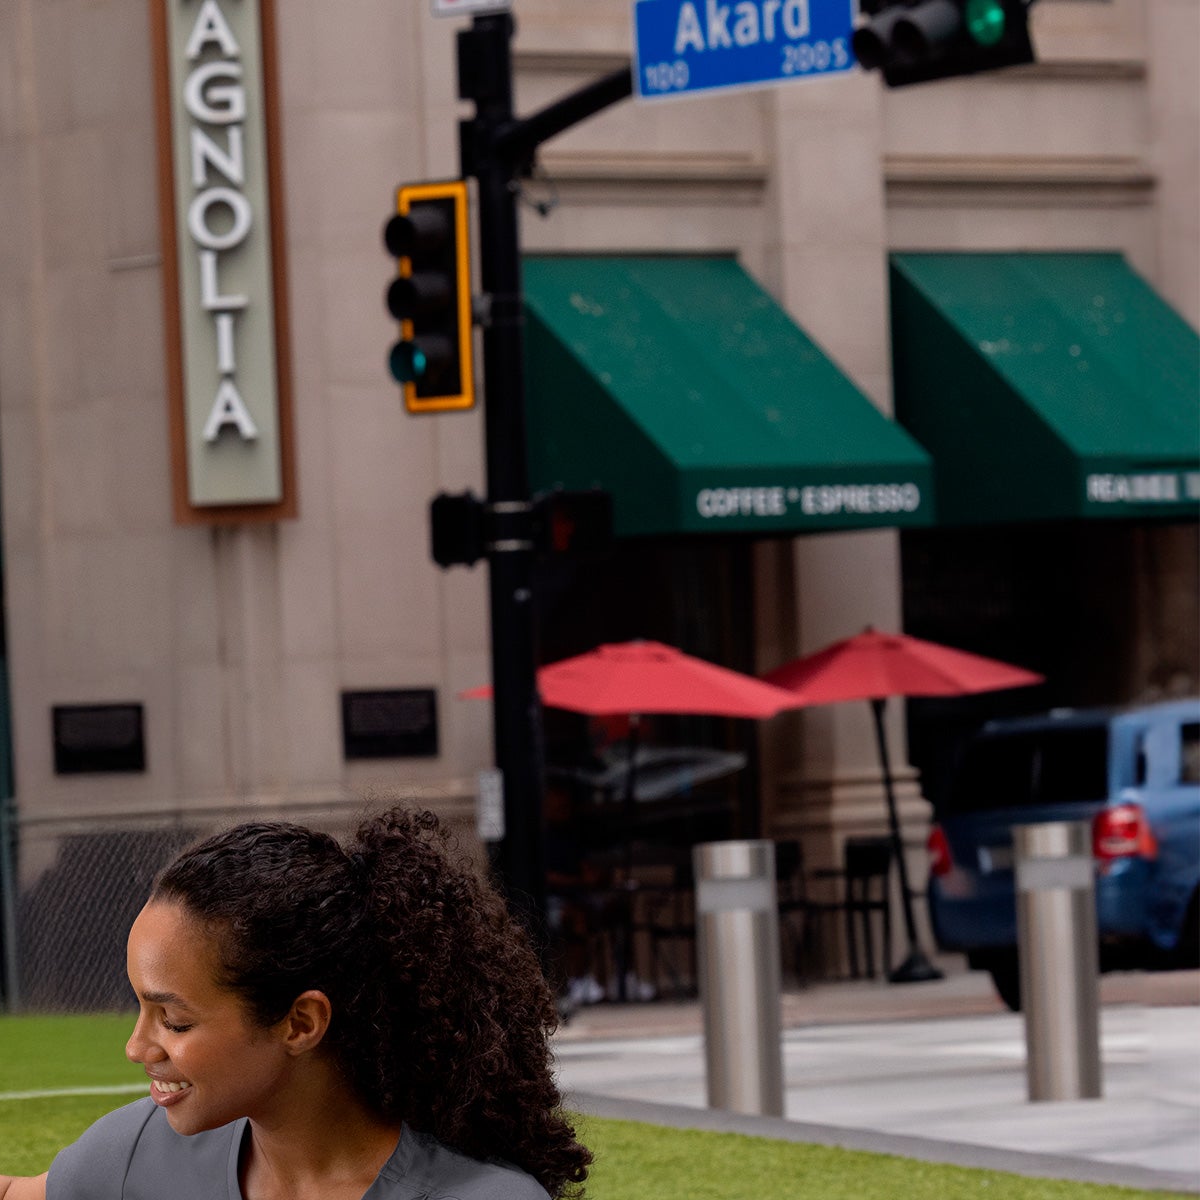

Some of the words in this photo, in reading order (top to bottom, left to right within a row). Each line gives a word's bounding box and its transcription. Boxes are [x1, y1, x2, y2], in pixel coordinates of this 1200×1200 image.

[674, 0, 811, 55] Akard
[646, 60, 690, 90] 100
[782, 41, 831, 74] 200
[696, 487, 787, 518] COFFEE
[801, 482, 921, 515] ESPRESSO
